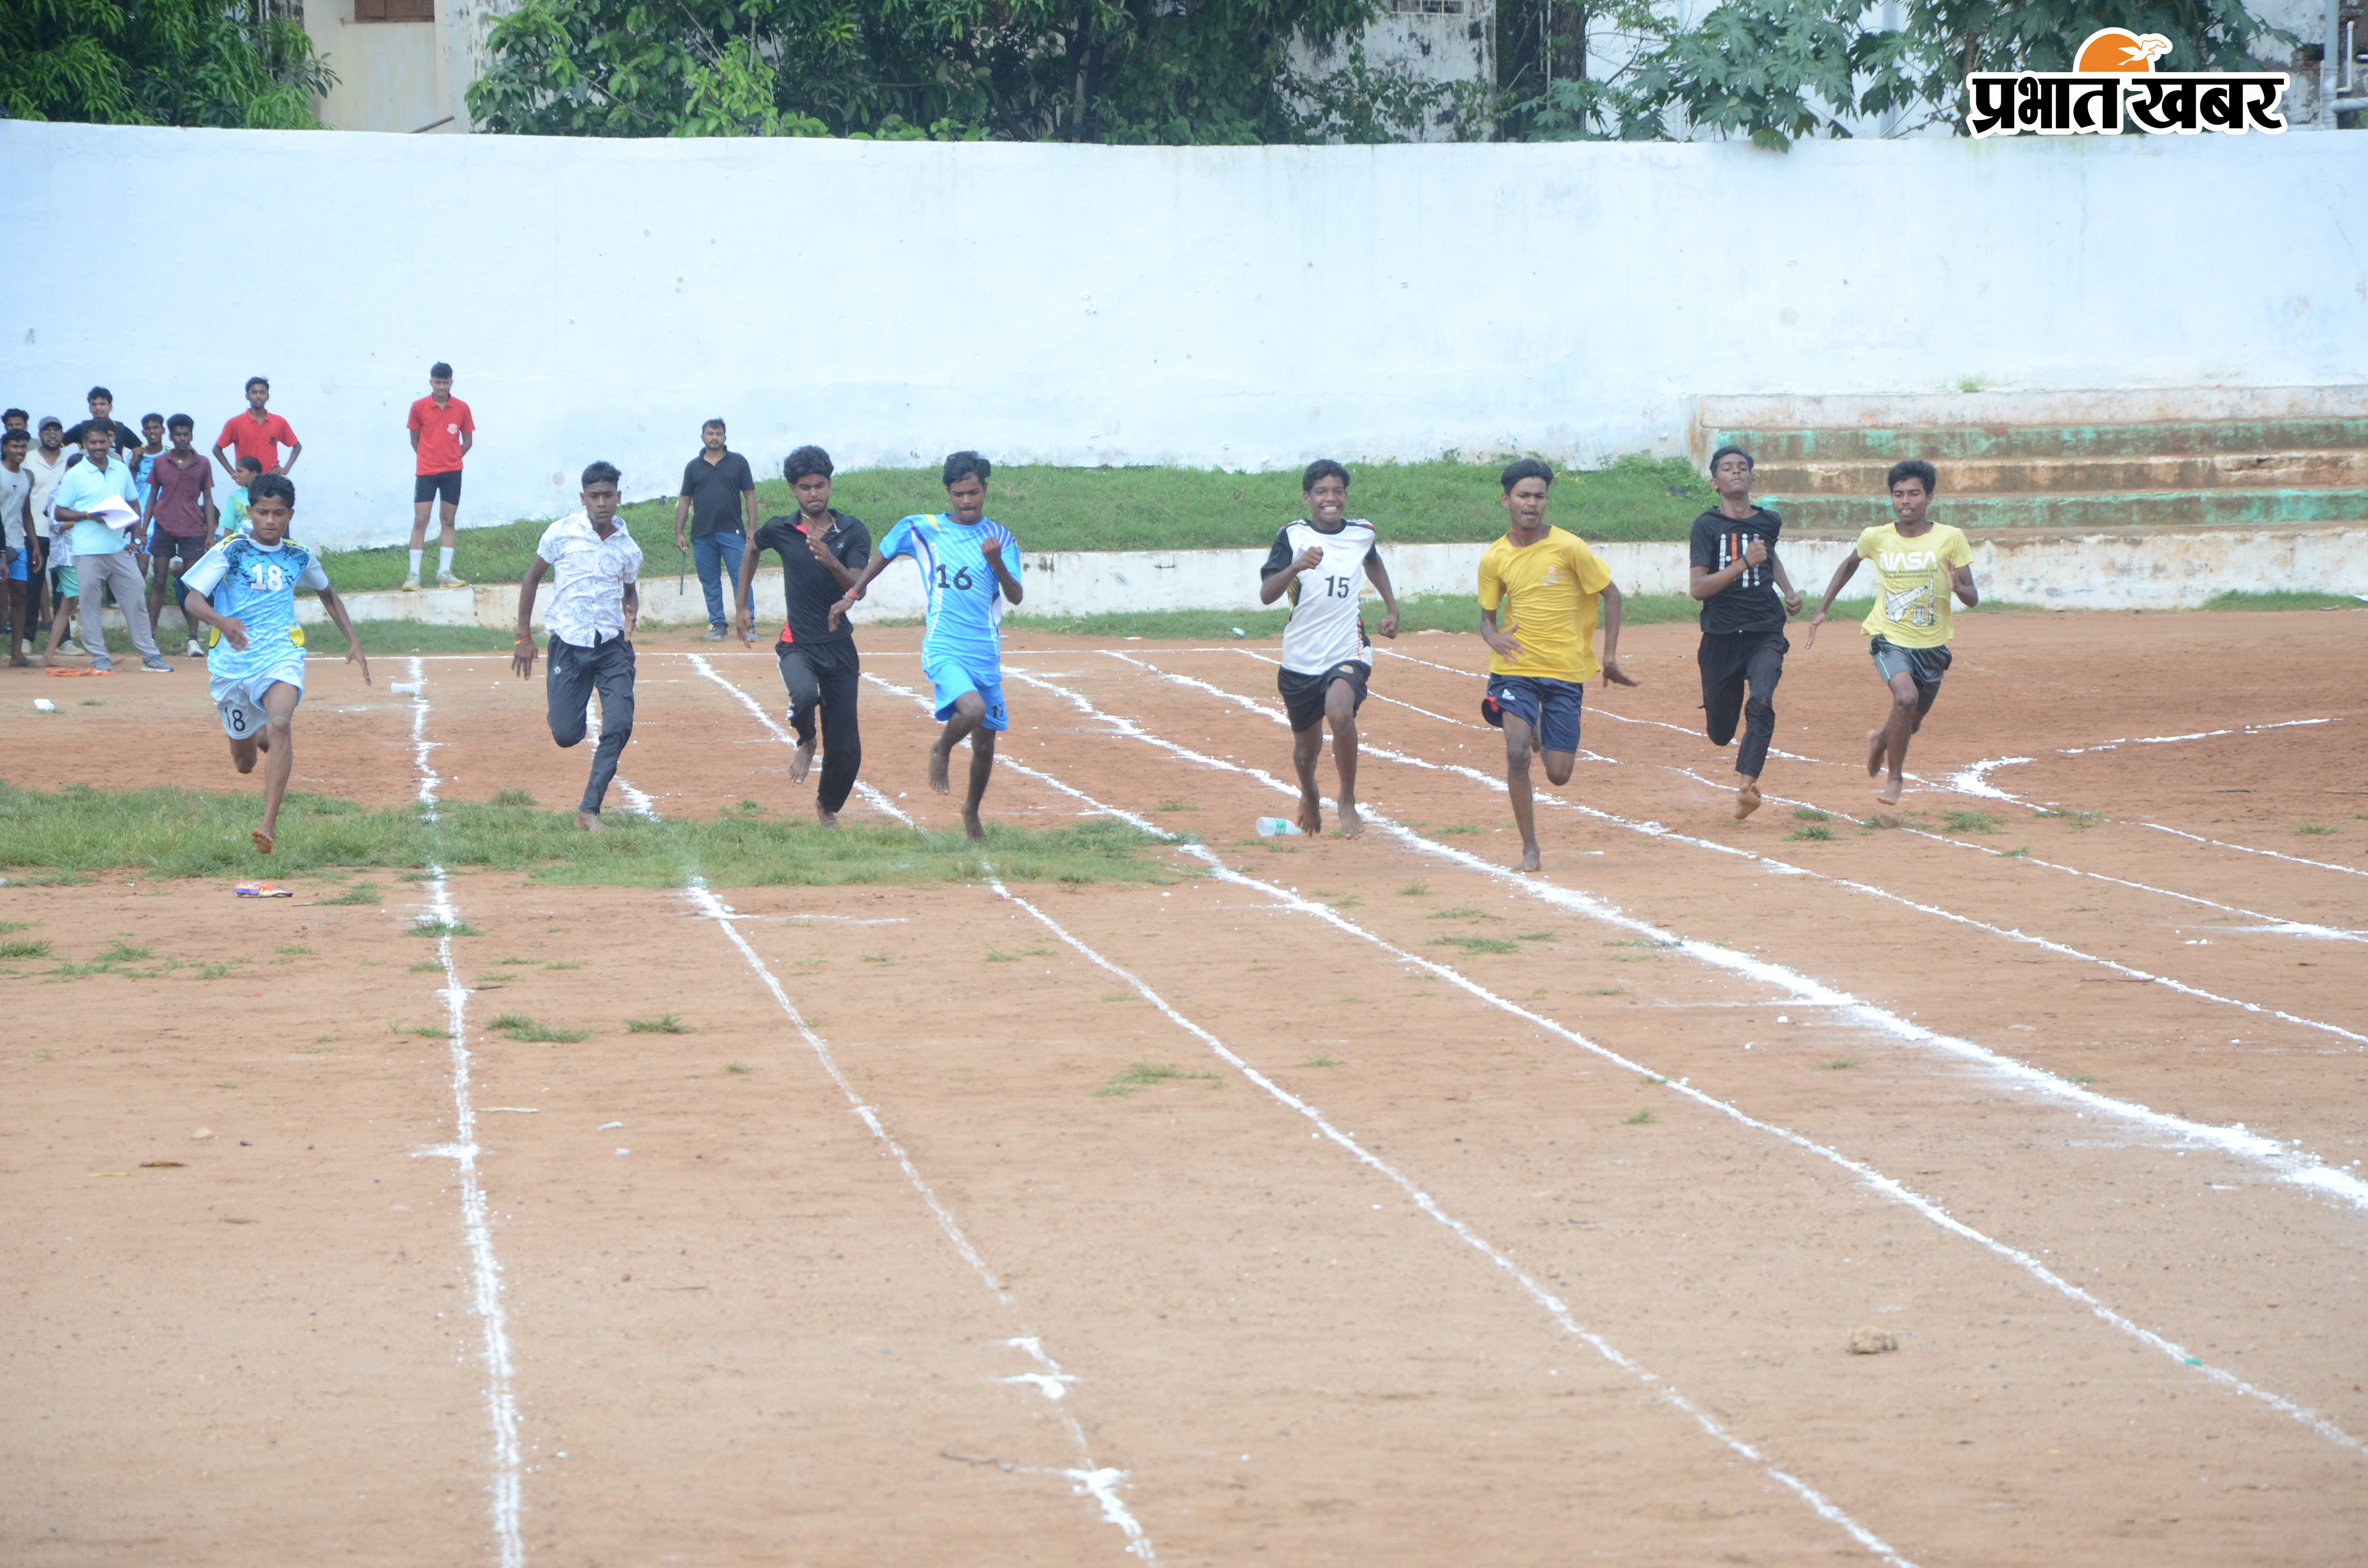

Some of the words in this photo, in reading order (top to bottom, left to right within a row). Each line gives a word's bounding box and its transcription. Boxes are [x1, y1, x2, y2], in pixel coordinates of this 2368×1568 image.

[1880, 551, 1938, 571] NASA
[250, 564, 283, 591] 18
[937, 564, 973, 590] 16
[1325, 575, 1350, 599] 15
[224, 706, 246, 732] 18
